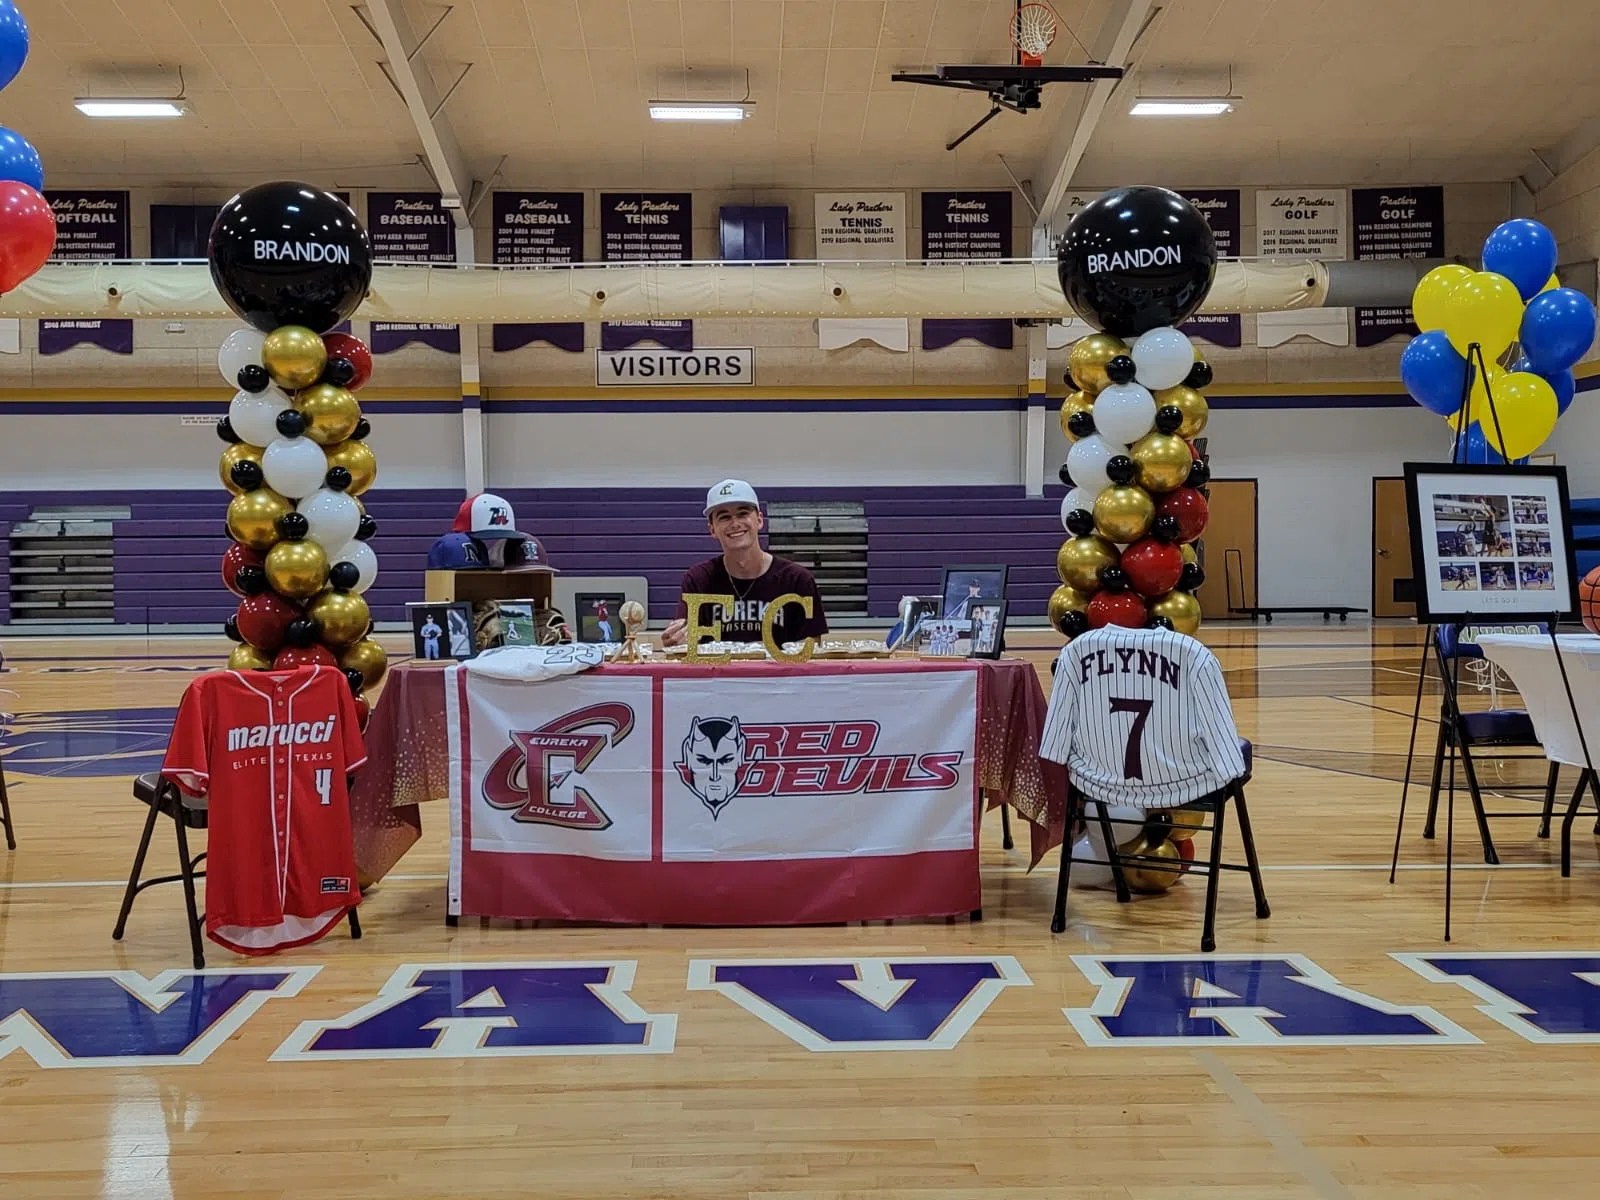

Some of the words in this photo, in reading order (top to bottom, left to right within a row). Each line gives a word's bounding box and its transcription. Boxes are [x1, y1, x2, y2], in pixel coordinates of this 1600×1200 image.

[50, 199, 75, 211] Lady
[78, 199, 118, 209] Panthers
[394, 200, 434, 211] Panthers
[519, 199, 558, 210] Panthers
[614, 201, 639, 213] Lady
[641, 200, 680, 211] Panthers
[947, 199, 986, 210] Panthers
[1190, 198, 1228, 208] Panthers
[1270, 196, 1294, 209] Lady
[1297, 196, 1335, 207] Panthers
[1379, 195, 1417, 207] Panthers
[829, 202, 854, 214] Lady
[855, 201, 893, 212] Panthers
[54, 213, 117, 223] OFTBALL
[380, 215, 447, 225] BASEBALL
[505, 213, 571, 224] BASEBALL
[624, 214, 669, 224] TENNIS
[946, 213, 989, 223] TENNIS
[1285, 210, 1318, 219] GOLF
[1381, 210, 1415, 219] GOLF
[840, 217, 883, 228] TENNIS
[254, 240, 350, 264] BRANDON
[1087, 245, 1181, 274] BRANDON
[610, 356, 742, 377] VISITORS
[721, 622, 761, 632] ASEBA
[1080, 648, 1181, 690] FLYNN
[228, 714, 336, 752] marucci
[1109, 697, 1154, 780] 7
[529, 737, 588, 747] EUREKA
[739, 720, 881, 759] RED
[233, 757, 268, 770] ELITE
[295, 752, 332, 763] TEXAS
[733, 751, 964, 796] DEVILS
[314, 768, 333, 805] 4
[528, 805, 588, 819] COLLEGE
